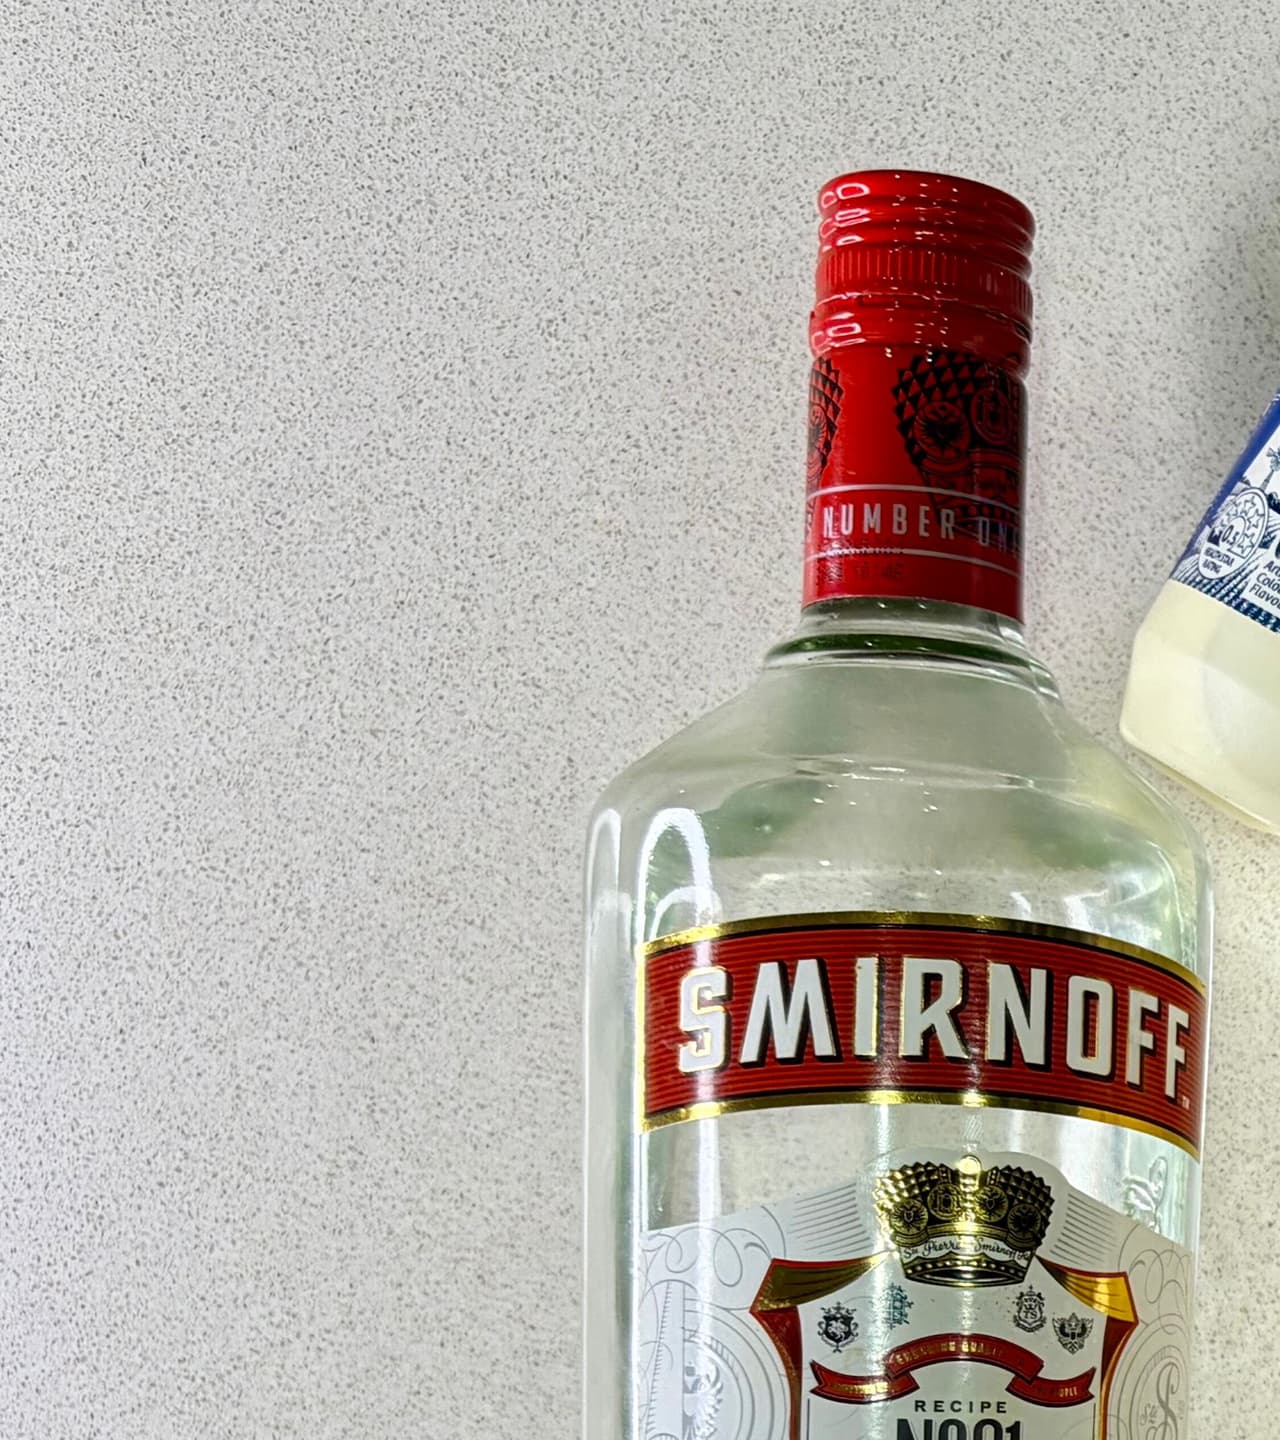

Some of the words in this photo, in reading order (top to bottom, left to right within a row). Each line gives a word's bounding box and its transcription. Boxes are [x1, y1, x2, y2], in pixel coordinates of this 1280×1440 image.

[823, 503, 955, 540] NUMBER
[677, 955, 1191, 1099] SMIRNOFF
[914, 1400, 1008, 1414] RECIPE
